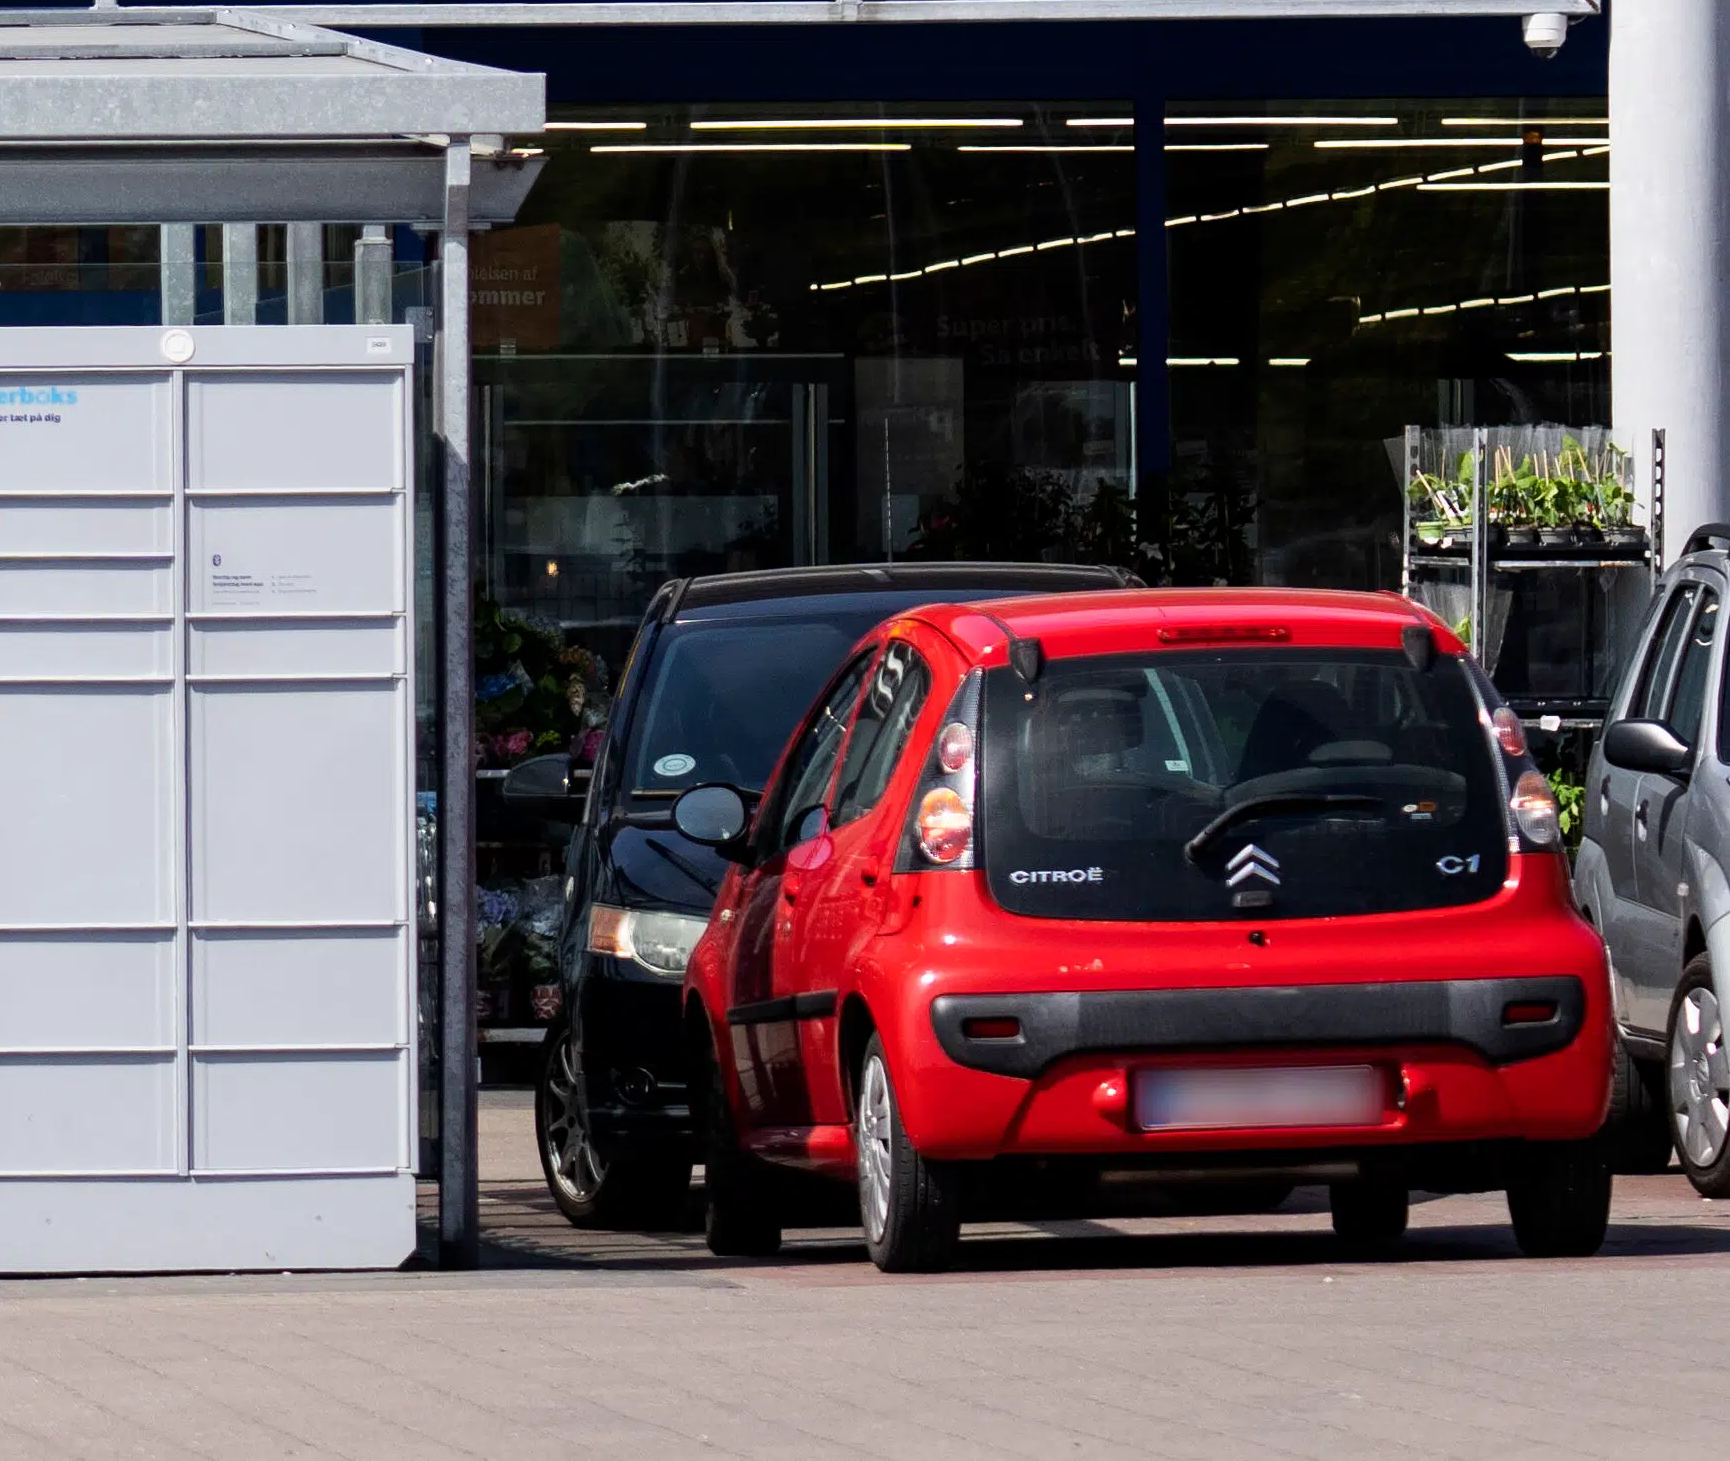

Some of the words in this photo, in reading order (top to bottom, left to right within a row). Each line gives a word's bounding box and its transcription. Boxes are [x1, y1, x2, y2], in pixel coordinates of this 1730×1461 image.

[469, 289, 546, 307] ommer
[44, 413, 61, 424] dig
[1435, 853, 1481, 874] C1
[1008, 866, 1104, 885] CITROË
